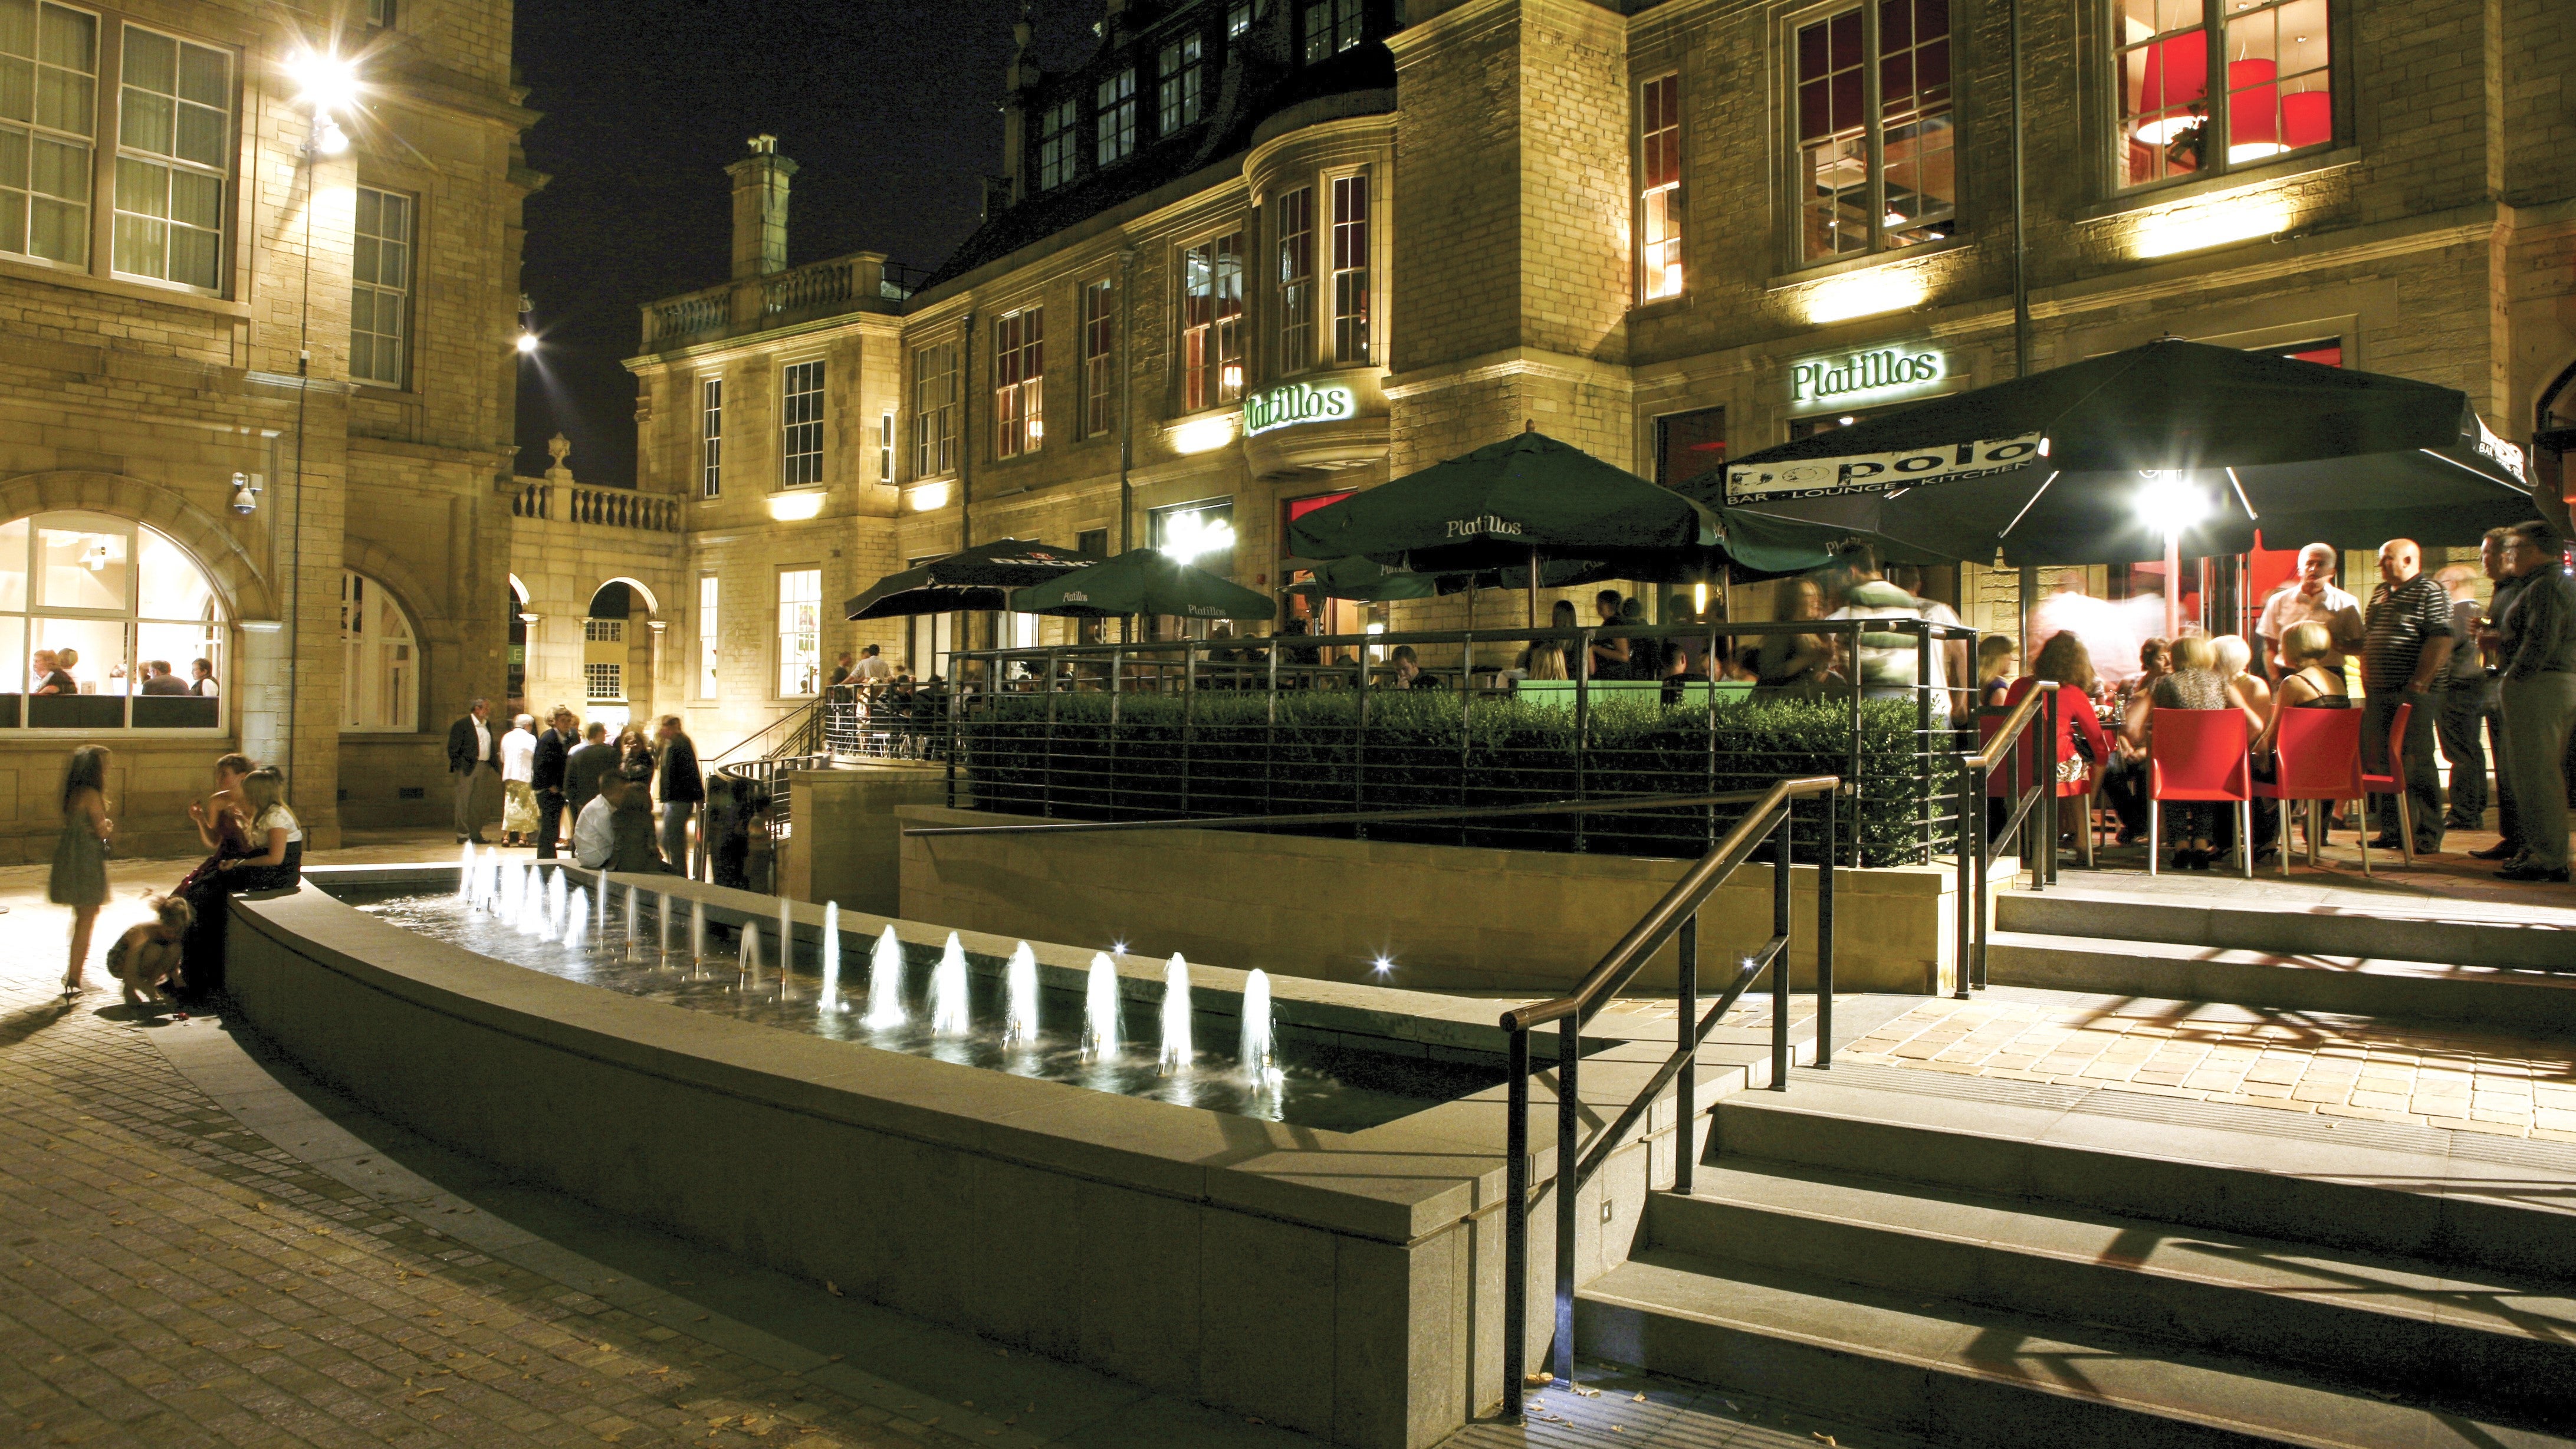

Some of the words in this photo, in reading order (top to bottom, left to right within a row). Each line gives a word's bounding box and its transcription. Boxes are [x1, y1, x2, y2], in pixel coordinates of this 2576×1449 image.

[1792, 350, 1938, 401] Platillos
[1243, 384, 1345, 436] Platillos
[1728, 493, 1768, 505] BAR
[1792, 482, 1897, 499] LOUNGE
[1921, 460, 2033, 485] KITCHEN
[1446, 515, 1522, 538] Platillos
[1187, 604, 1226, 616] Platillos
